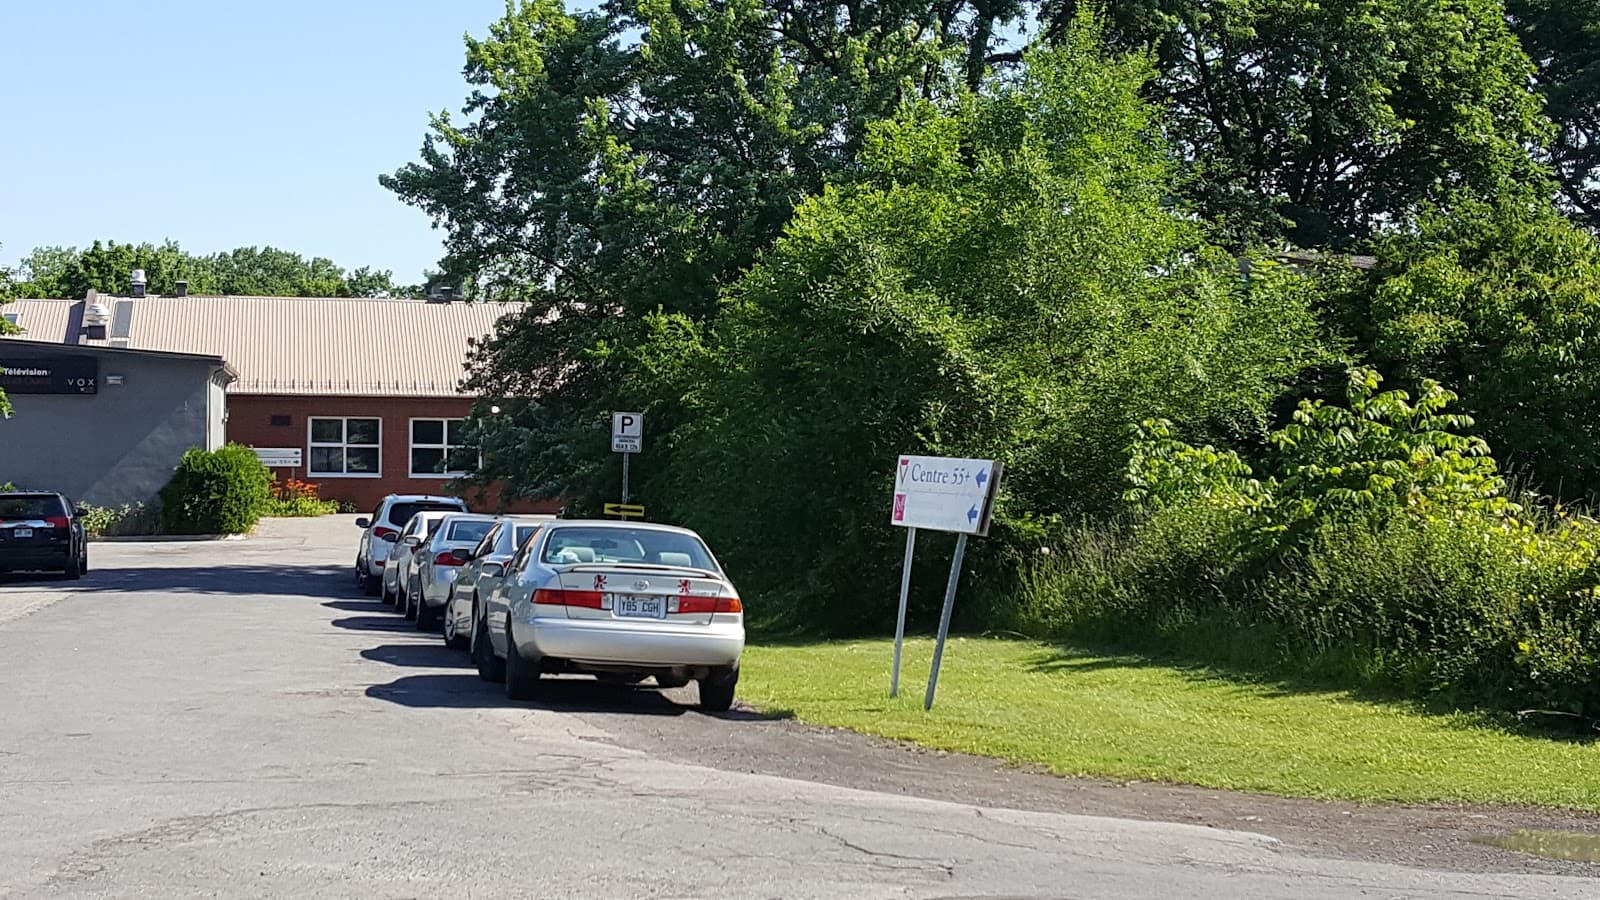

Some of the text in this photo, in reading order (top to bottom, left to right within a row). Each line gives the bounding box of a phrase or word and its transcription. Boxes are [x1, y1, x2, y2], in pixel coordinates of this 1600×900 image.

[4, 367, 48, 376] Télévision
[67, 378, 95, 387] VOX
[621, 416, 634, 433] P
[911, 463, 949, 484] Centre
[951, 467, 971, 485] 55+
